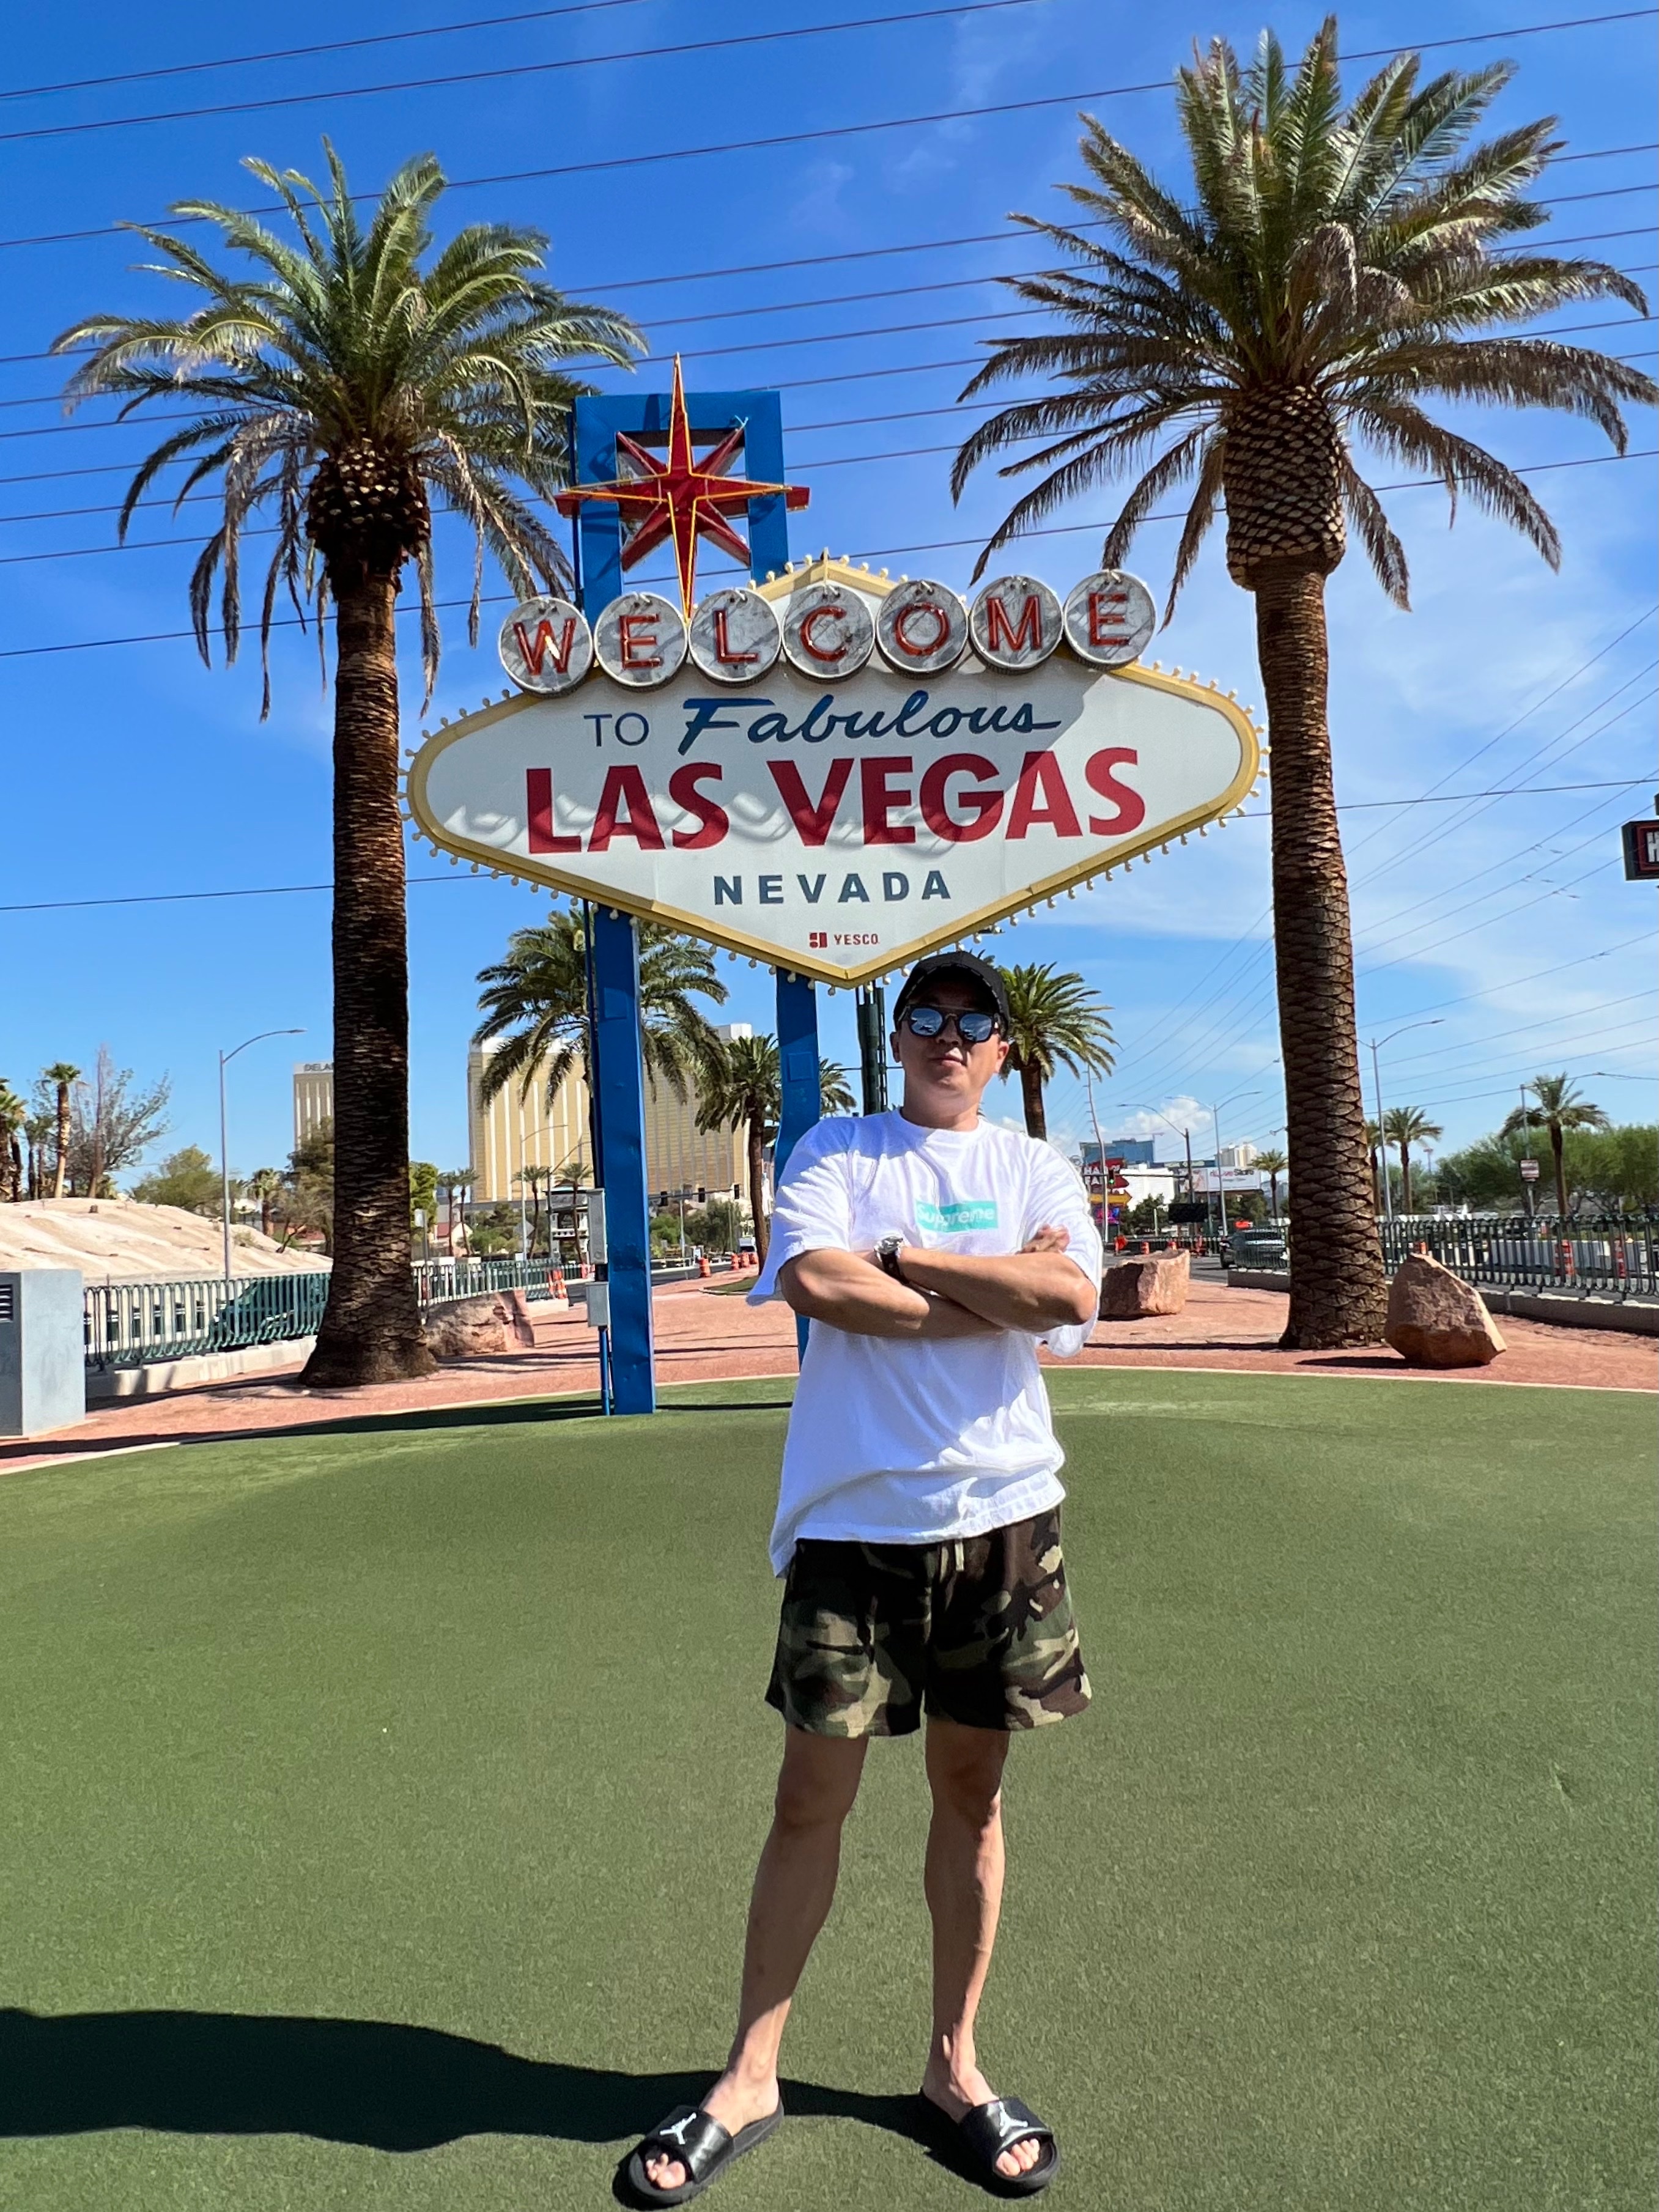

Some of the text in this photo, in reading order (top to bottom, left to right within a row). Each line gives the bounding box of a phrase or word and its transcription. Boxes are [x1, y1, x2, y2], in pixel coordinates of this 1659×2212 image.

[512, 592, 1131, 676] WELCOME
[583, 690, 1062, 756] TO Fabulous
[525, 747, 1146, 854] LAS VEGAS
[714, 869, 951, 905] NEVADA
[833, 933, 879, 945] YESCO
